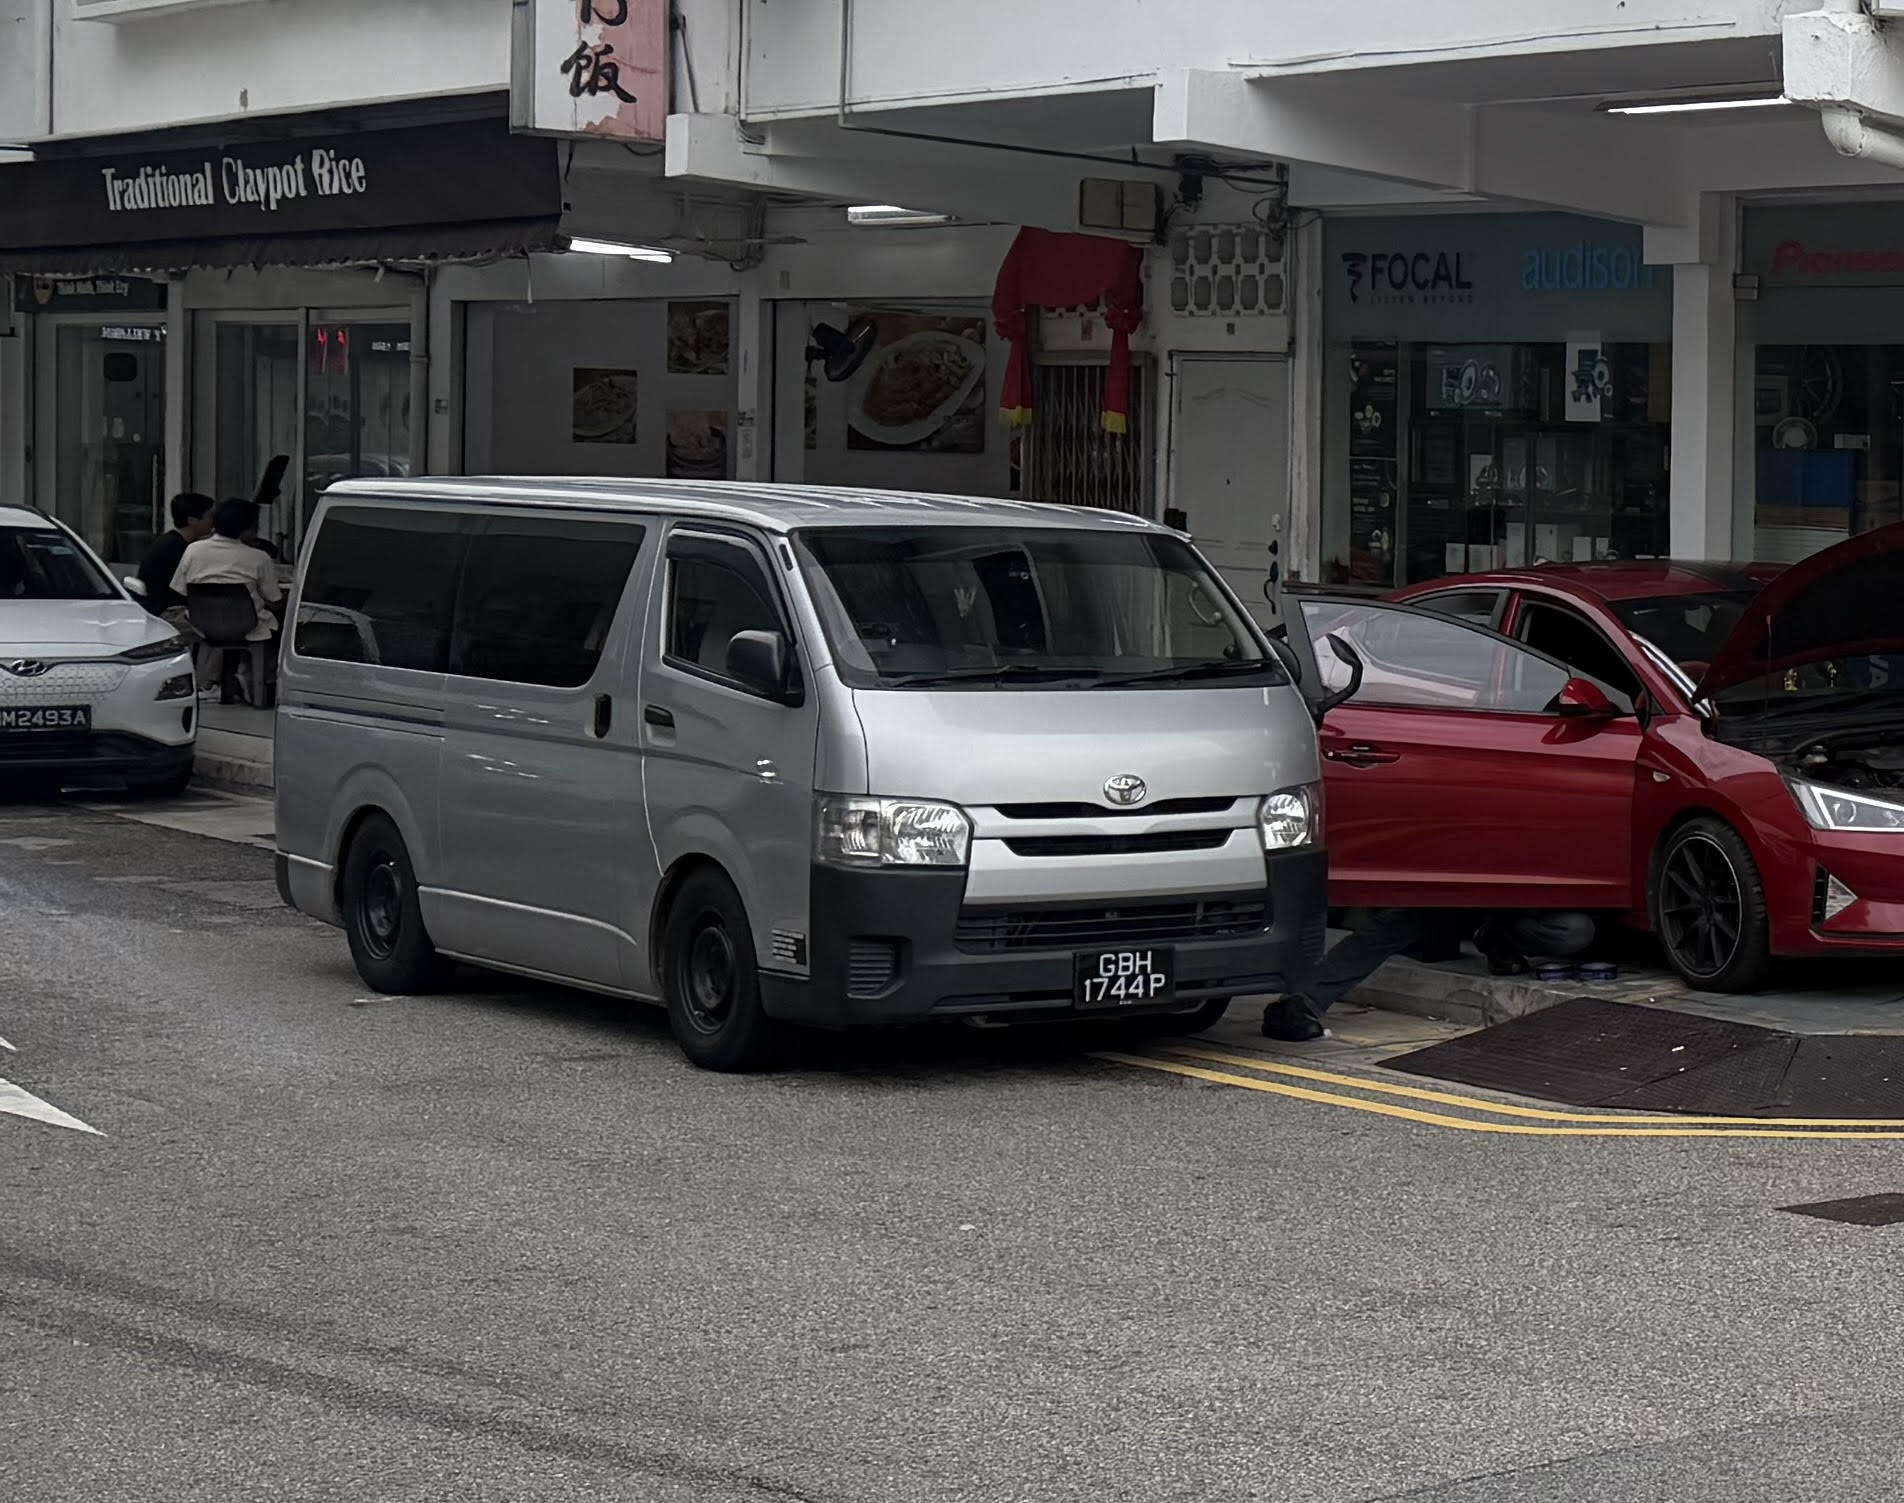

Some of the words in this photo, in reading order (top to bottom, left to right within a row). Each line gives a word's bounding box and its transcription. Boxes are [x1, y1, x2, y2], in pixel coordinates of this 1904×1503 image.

[101, 161, 215, 211] Traditional
[222, 154, 307, 211] Claypot
[311, 148, 366, 196] Rice
[1371, 252, 1473, 291] FOCAL
[0, 709, 87, 727] M2493A
[1099, 950, 1153, 977] GBH
[1084, 973, 1166, 1003] 1744P
